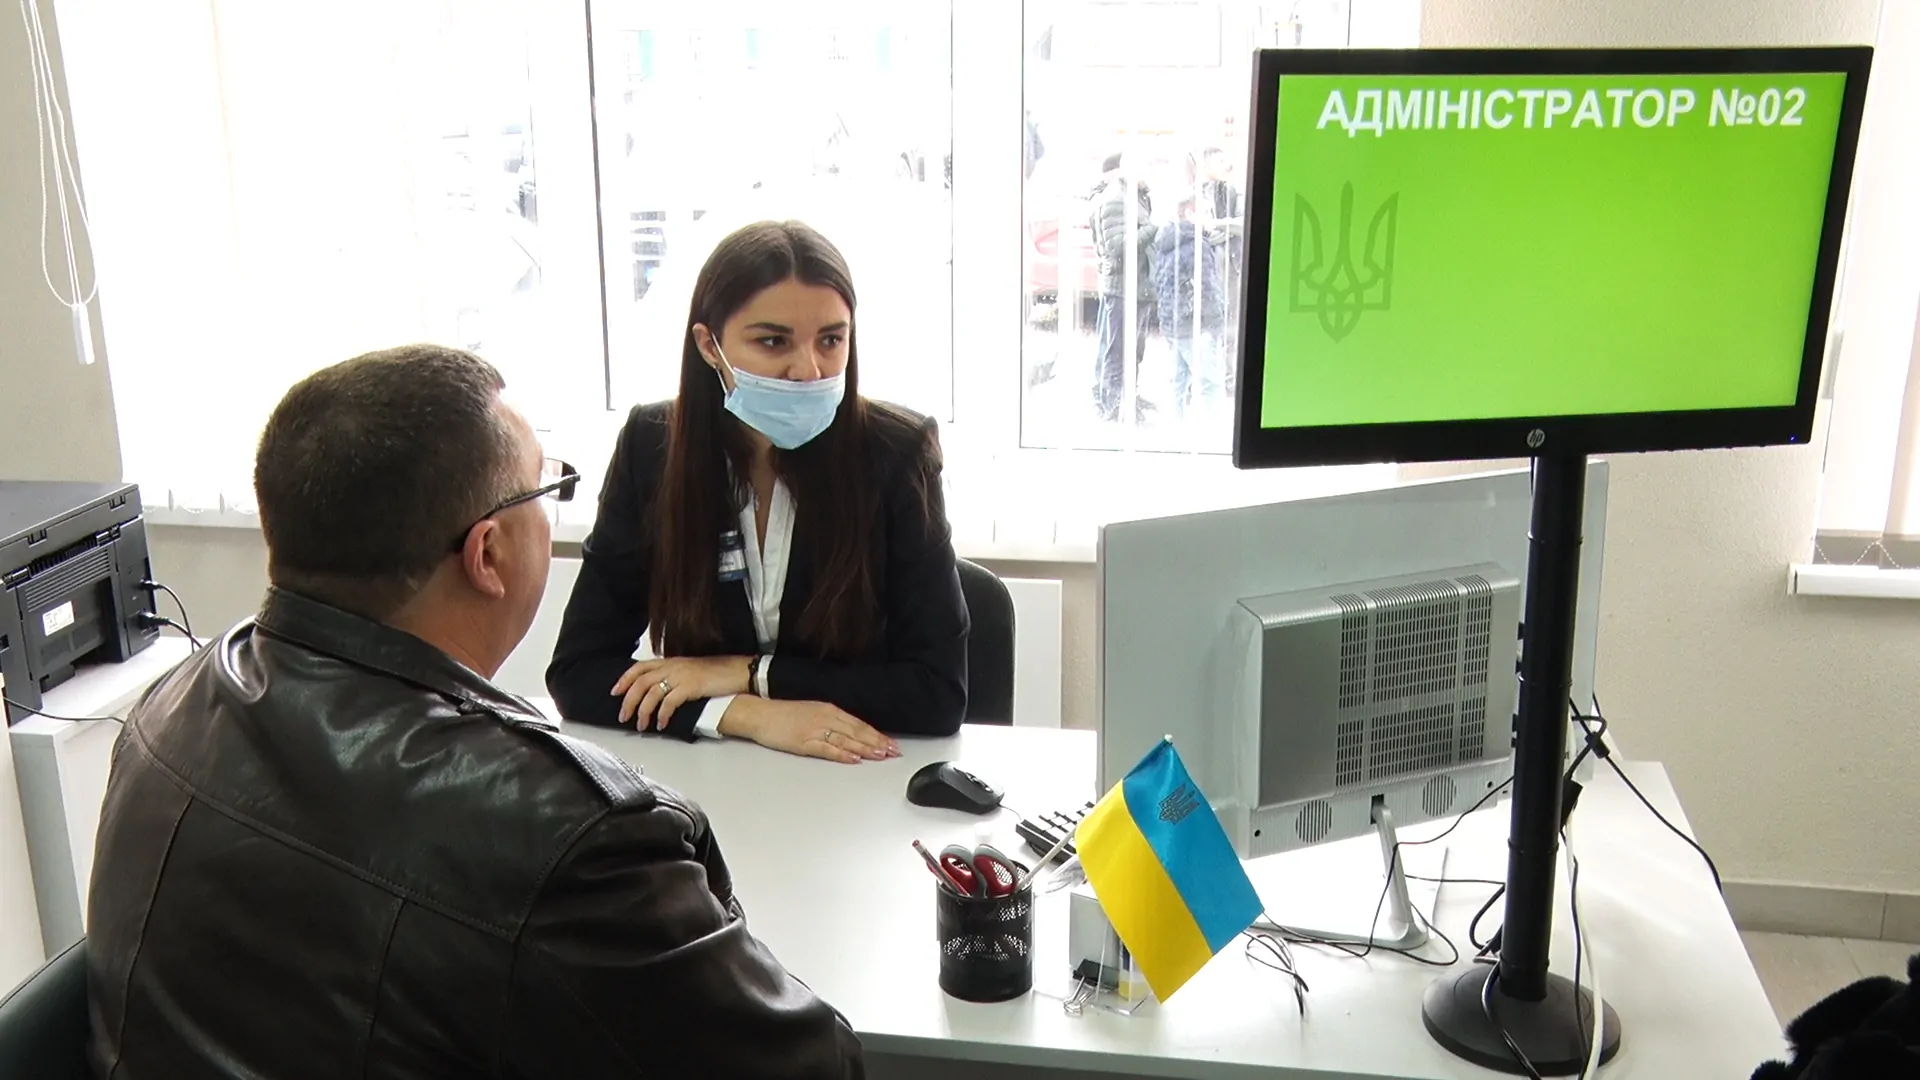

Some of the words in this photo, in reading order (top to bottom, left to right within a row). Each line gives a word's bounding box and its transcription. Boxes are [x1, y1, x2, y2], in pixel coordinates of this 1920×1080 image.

[1316, 89, 1695, 137] АДМІНІСТРАТОР
[1708, 88, 1806, 126] №02
[1528, 429, 1545, 448] hp
